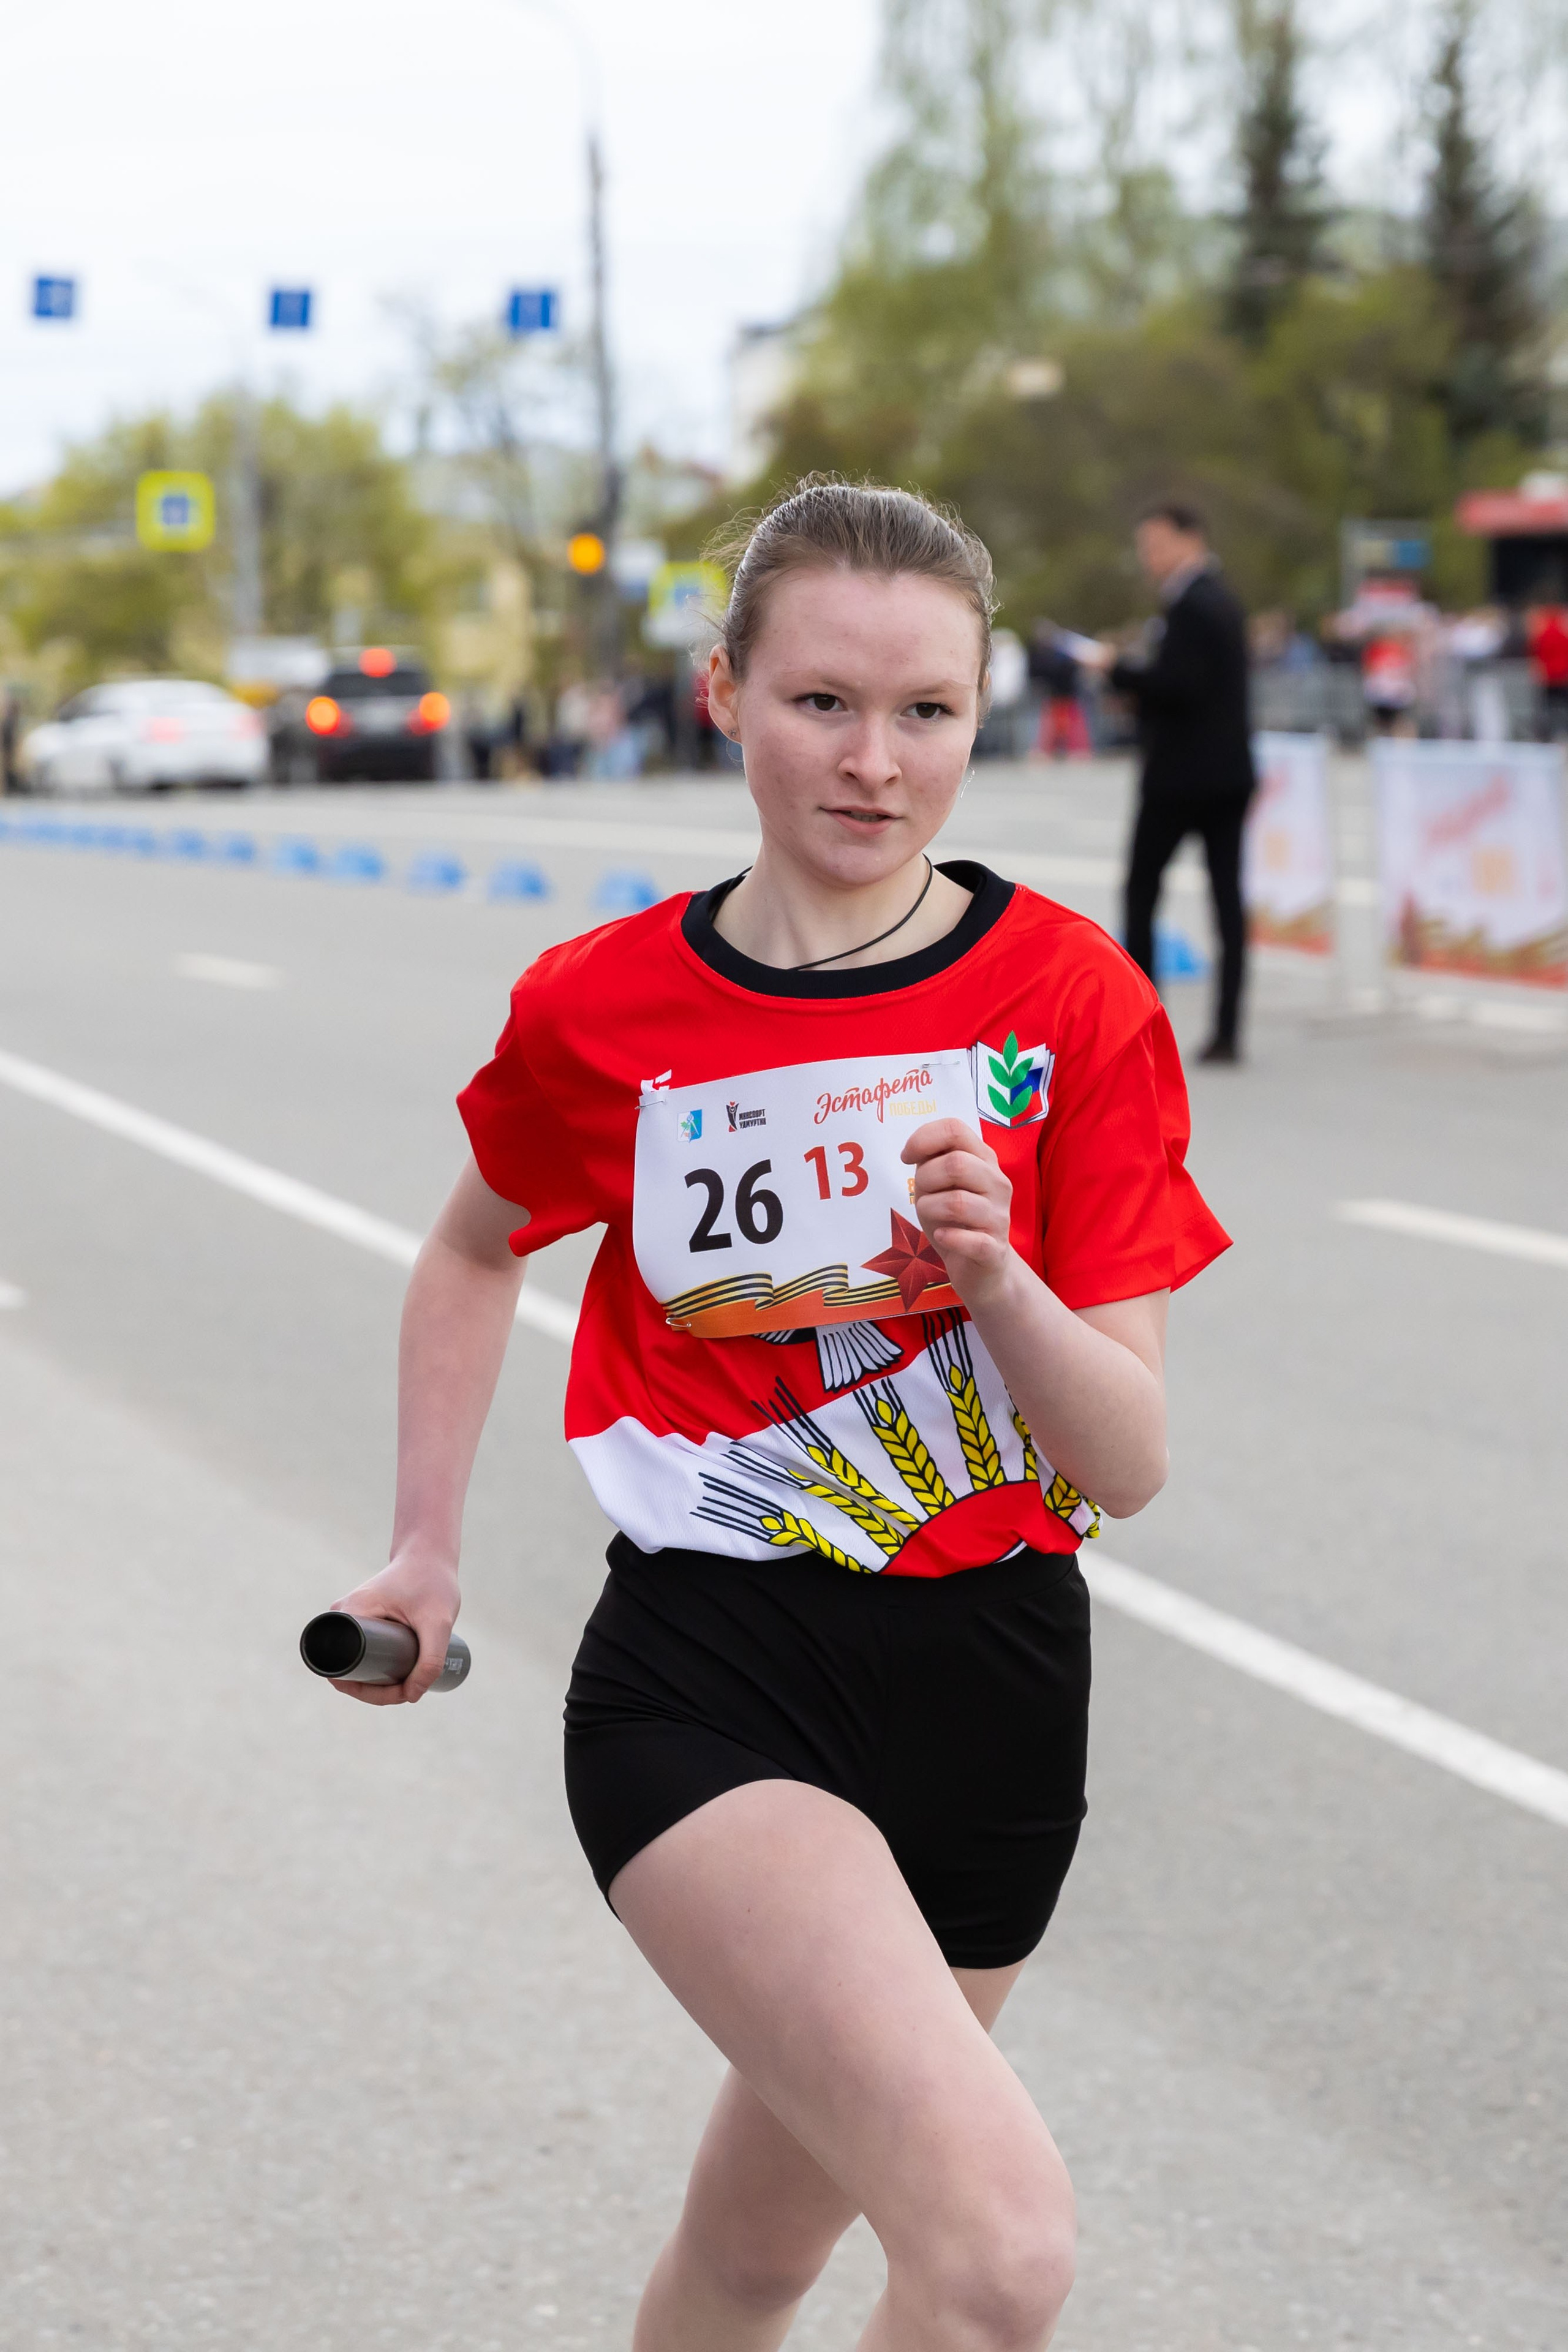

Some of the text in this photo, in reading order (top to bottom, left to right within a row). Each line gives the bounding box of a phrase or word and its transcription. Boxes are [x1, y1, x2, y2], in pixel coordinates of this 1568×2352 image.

[814, 1069, 933, 1125] Эстафета
[890, 1099, 937, 1116] ПОБЕДЫ
[804, 1142, 869, 1200] 13
[684, 1159, 783, 1253] 26
